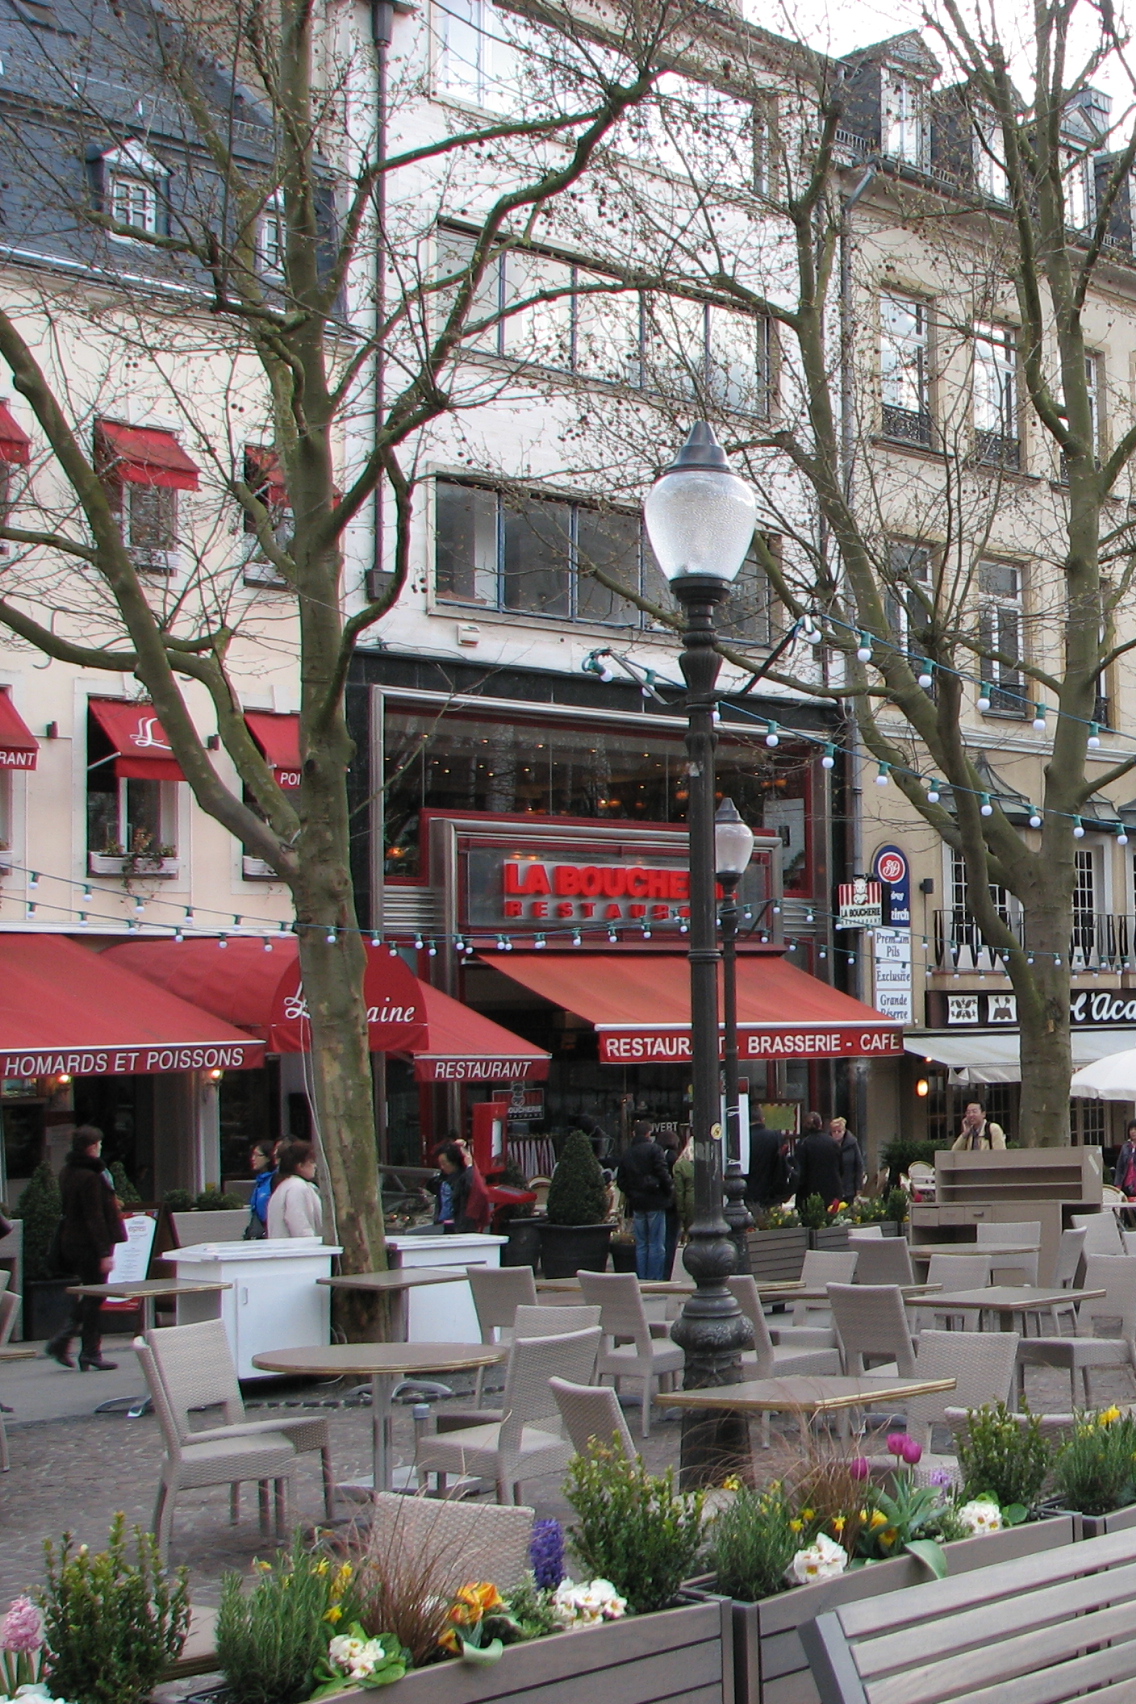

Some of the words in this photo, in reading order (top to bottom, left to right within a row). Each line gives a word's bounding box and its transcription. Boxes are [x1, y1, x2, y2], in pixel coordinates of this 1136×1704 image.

[504, 863, 551, 895] LA
[554, 866, 738, 899] BOUCHE
[505, 900, 691, 920] RESTAUR
[841, 908, 848, 917] LA
[849, 906, 881, 917] BOUCHERIE
[886, 945, 900, 957] Pils
[366, 996, 416, 1022] aine
[880, 994, 907, 1006] Grande
[606, 1036, 726, 1057] RESTAURT
[747, 1034, 841, 1054] BRASSERIE
[859, 1033, 900, 1050] CAFE
[4, 1053, 108, 1076] HOMARDS
[114, 1052, 140, 1071] ET
[146, 1047, 244, 1065] POISSONS
[434, 1061, 532, 1079] RESTAURANT
[507, 1105, 543, 1114] OUCHERIE
